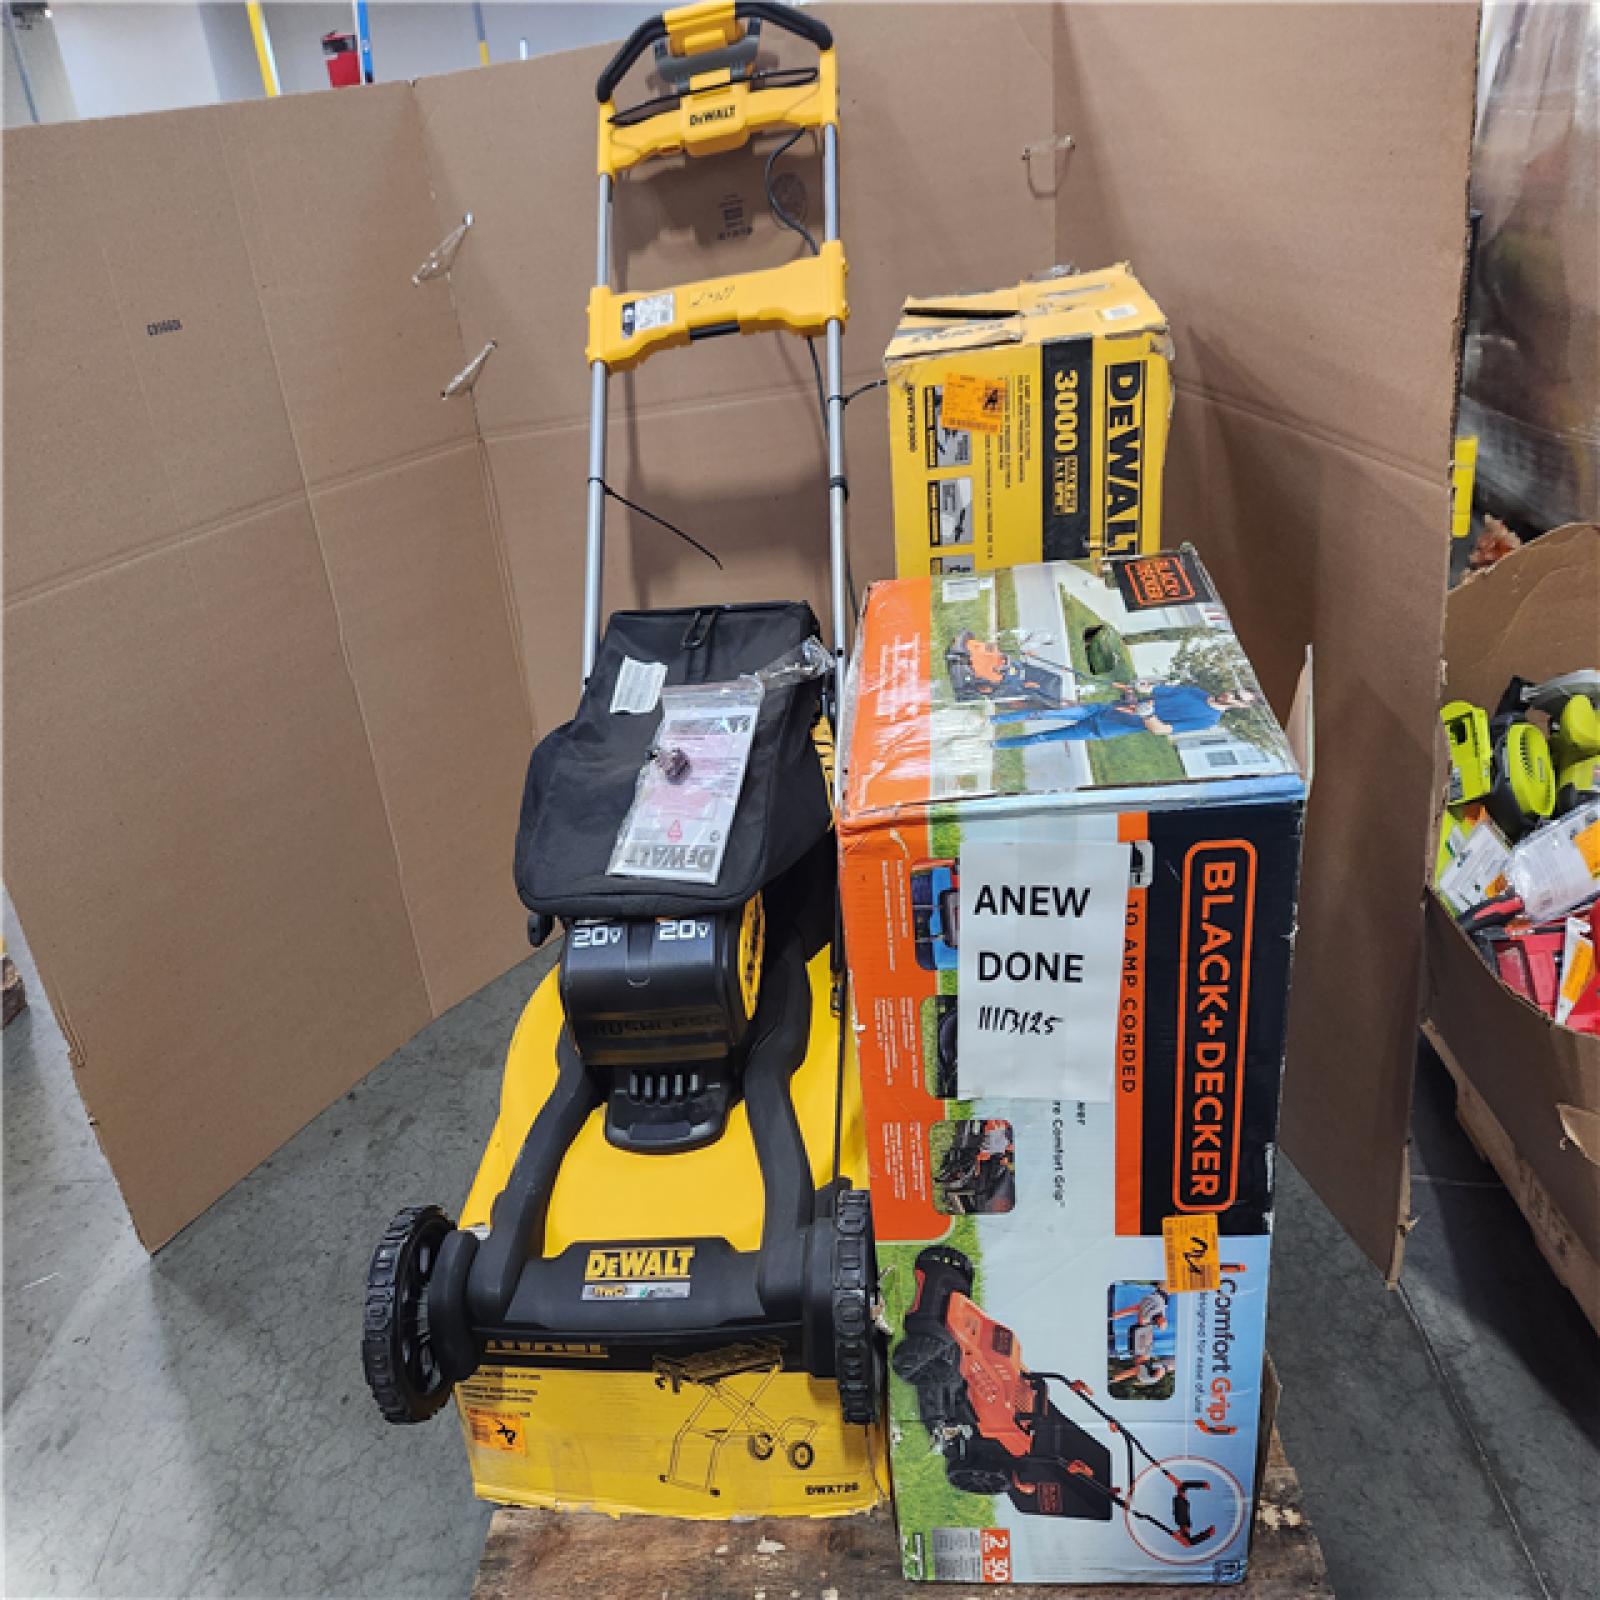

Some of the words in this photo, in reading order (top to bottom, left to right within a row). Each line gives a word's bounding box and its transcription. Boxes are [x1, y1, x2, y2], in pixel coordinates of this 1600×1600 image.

[1054, 369, 1078, 452] 3000
[973, 884, 1091, 918] ANEW
[977, 951, 1084, 984] DONE
[1123, 938, 1139, 989] AMP
[1121, 998, 1138, 1093] CORDED
[1190, 861, 1237, 1197] BLACK+DECKER
[587, 1248, 692, 1277] DEWALT
[1211, 1278, 1239, 1375] Comfort
[1206, 1376, 1232, 1421] Grip
